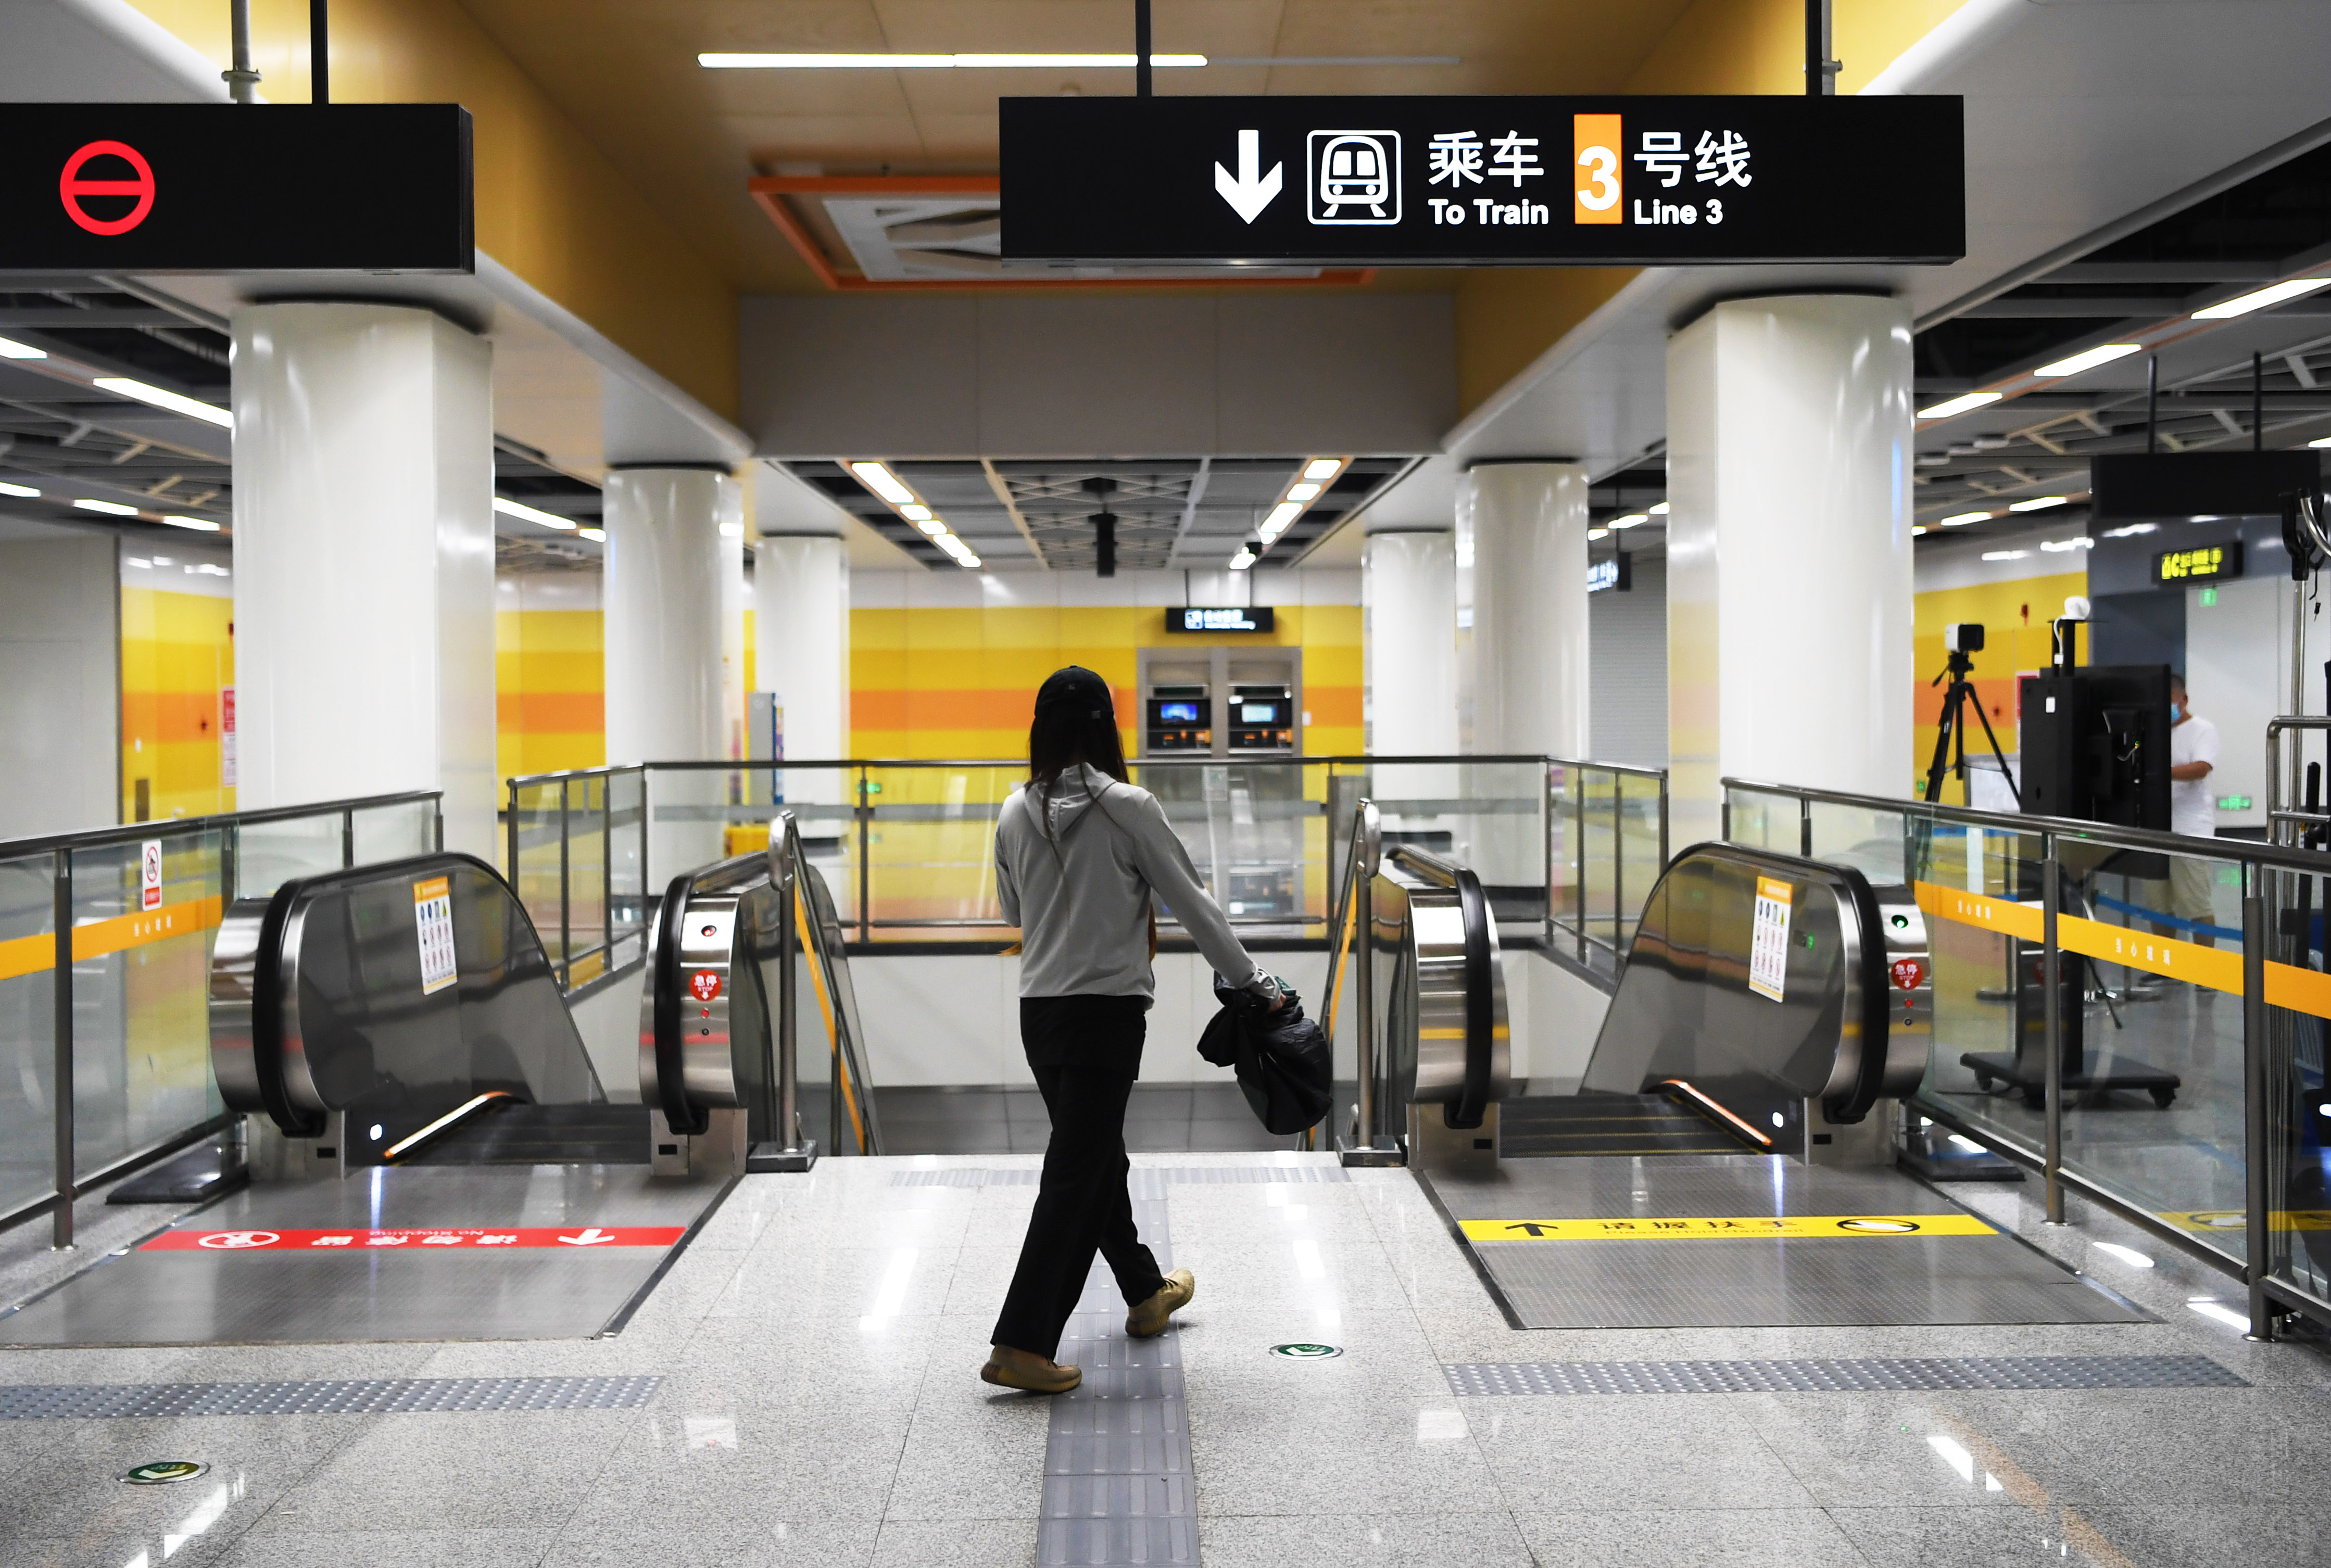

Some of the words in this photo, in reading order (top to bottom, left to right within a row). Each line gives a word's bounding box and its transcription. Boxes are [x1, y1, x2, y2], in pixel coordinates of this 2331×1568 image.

[1428, 130, 1544, 187] 乘车
[1577, 145, 1620, 211] 3
[1634, 130, 1753, 188] 号线
[1428, 198, 1465, 224] To
[1473, 198, 1548, 224] Train
[1634, 199, 1697, 224] Line
[1706, 199, 1723, 224] 3
[1895, 964, 1918, 975] 急停
[694, 975, 717, 987] 急停
[1598, 1220, 1797, 1229] 请握扶手
[311, 1235, 518, 1246] 请勿停留
